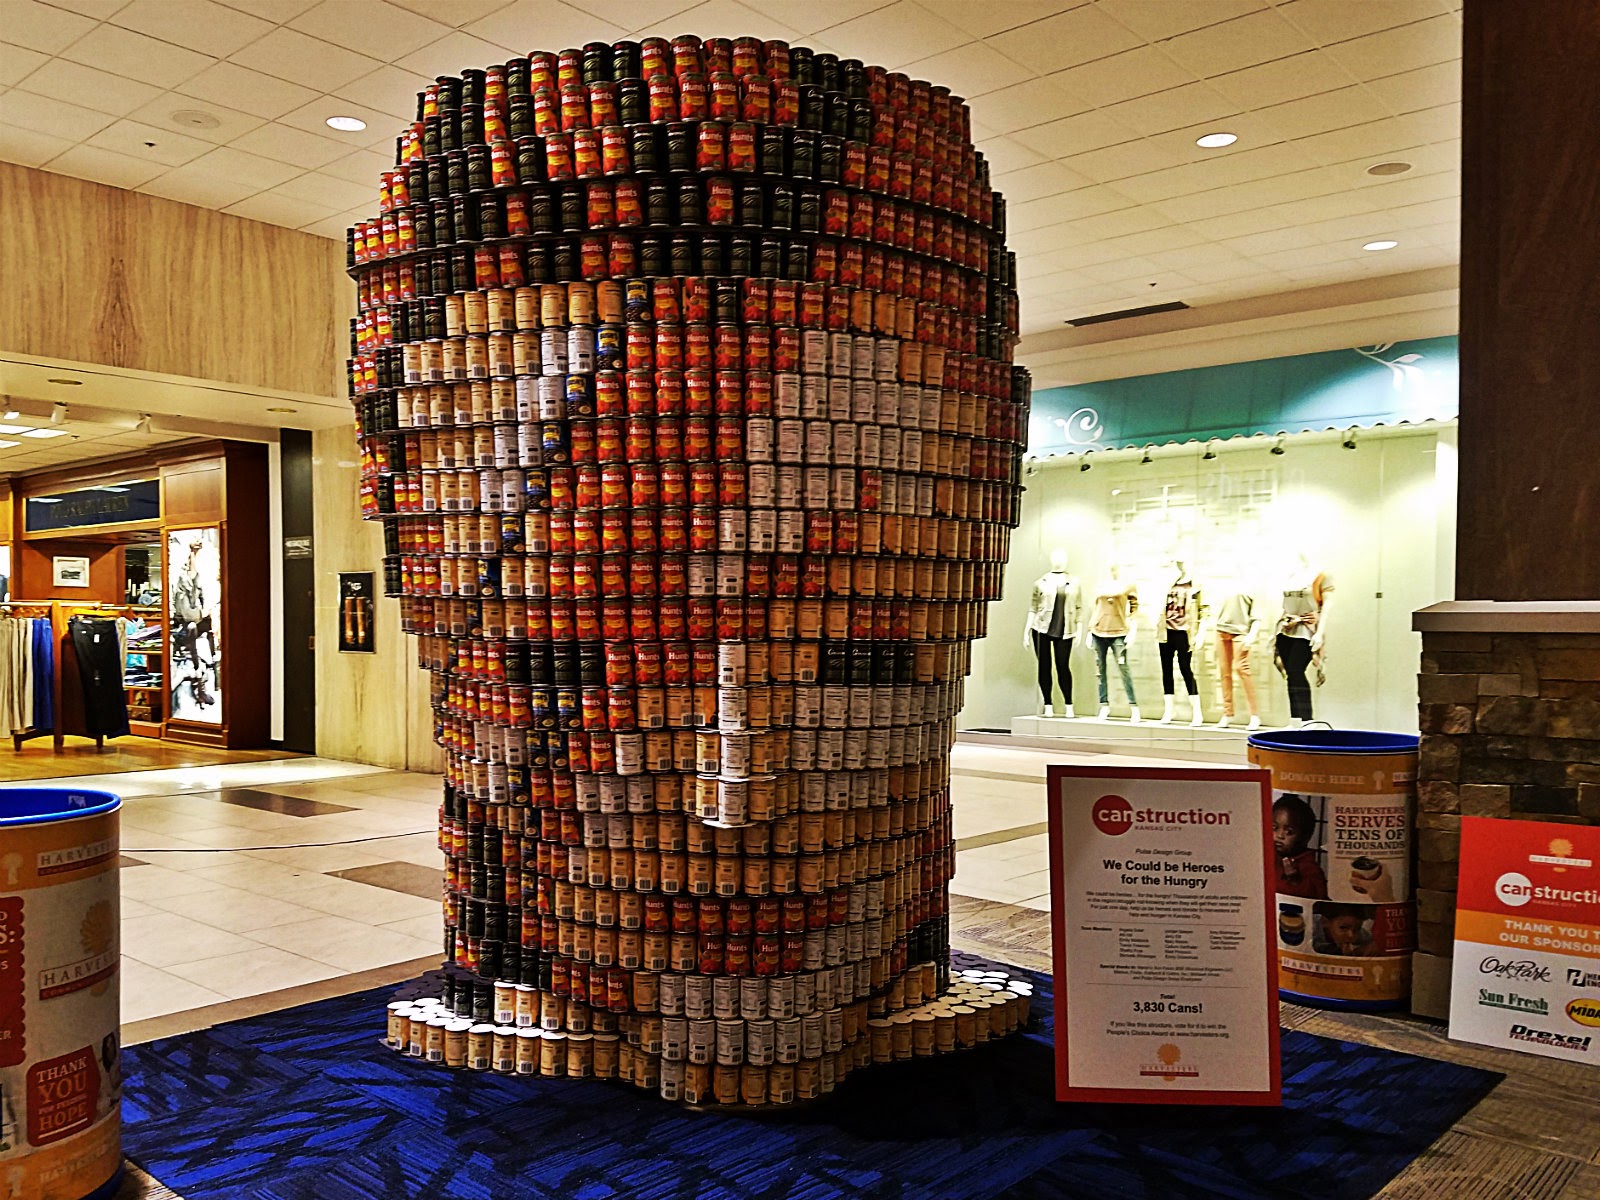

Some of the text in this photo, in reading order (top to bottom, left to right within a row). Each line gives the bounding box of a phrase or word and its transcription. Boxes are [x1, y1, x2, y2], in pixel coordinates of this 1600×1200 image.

[1280, 771, 1364, 785] DONATE HERE
[1335, 815, 1405, 828] SERVES
[1335, 828, 1405, 841] TENS OF
[1335, 840, 1406, 851] THOUSANDS
[1103, 859, 1225, 874] We Could be Heroes
[1121, 873, 1208, 889] for the Hungry
[1500, 883, 1600, 904] canstructi
[1504, 920, 1554, 934] THANK
[1559, 926, 1589, 938] YOU
[1499, 932, 1529, 944] OUR
[1479, 956, 1553, 983] Oak Park
[1133, 1001, 1203, 1014] 3,830 Cans!
[1479, 988, 1504, 1002] Sun
[1508, 993, 1549, 1010] Fresh
[1511, 1024, 1592, 1047] Drexel
[36, 1056, 88, 1083] THANK
[38, 1071, 87, 1105] YOU
[39, 1101, 87, 1132] HOPE
